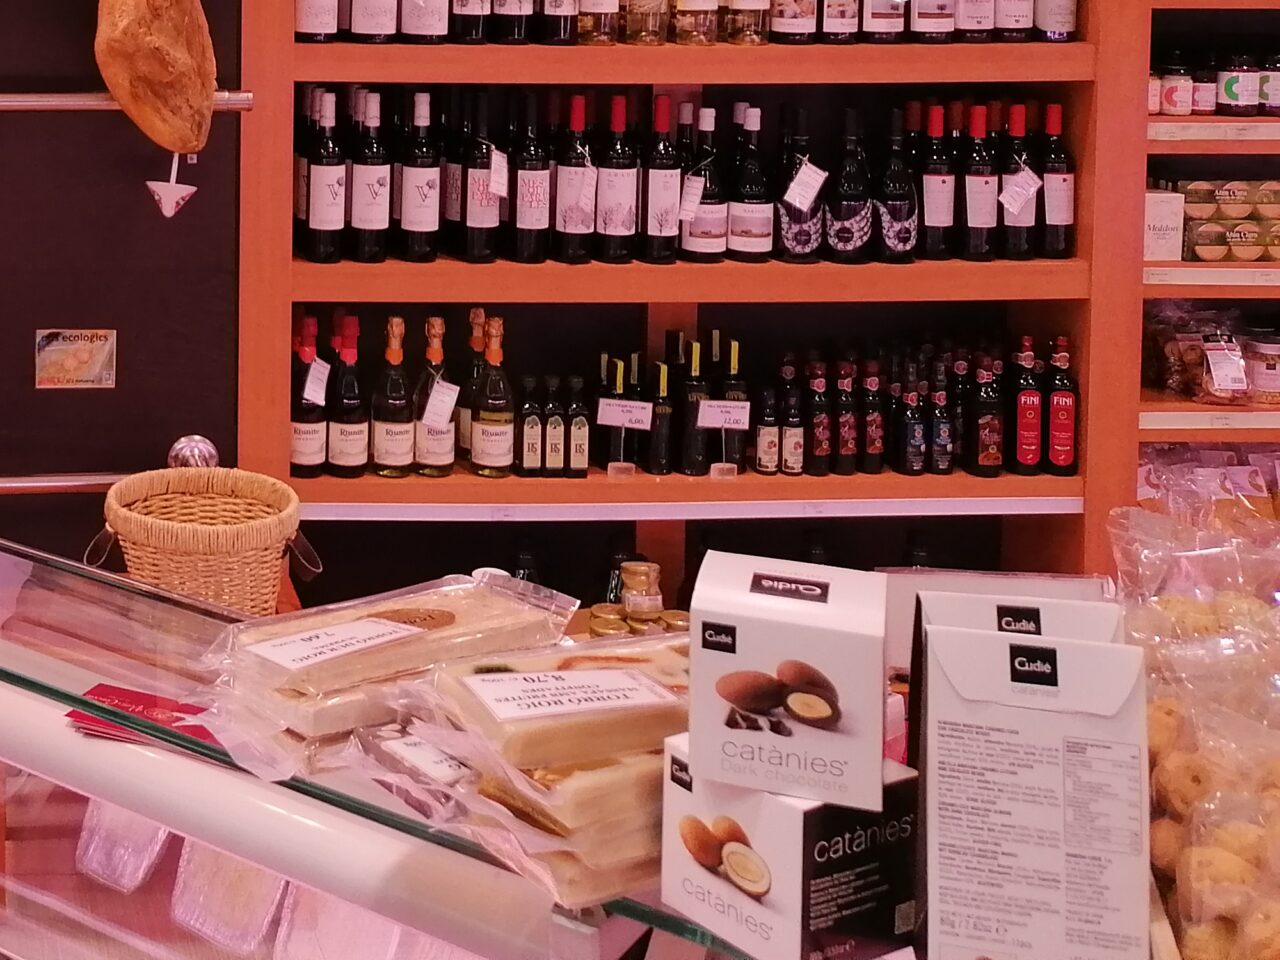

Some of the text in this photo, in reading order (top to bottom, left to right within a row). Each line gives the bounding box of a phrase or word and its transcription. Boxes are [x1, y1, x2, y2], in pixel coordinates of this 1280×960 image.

[1147, 224, 1179, 233] Maldon
[1021, 396, 1040, 405] FINI
[1053, 396, 1073, 406] FINI
[762, 578, 822, 595] Cudié
[1001, 616, 1036, 632] Cudié
[1014, 656, 1052, 674] Cudié
[522, 673, 567, 685] 8,70
[516, 698, 564, 711] ROIG
[720, 757, 849, 793] Dark chocolate
